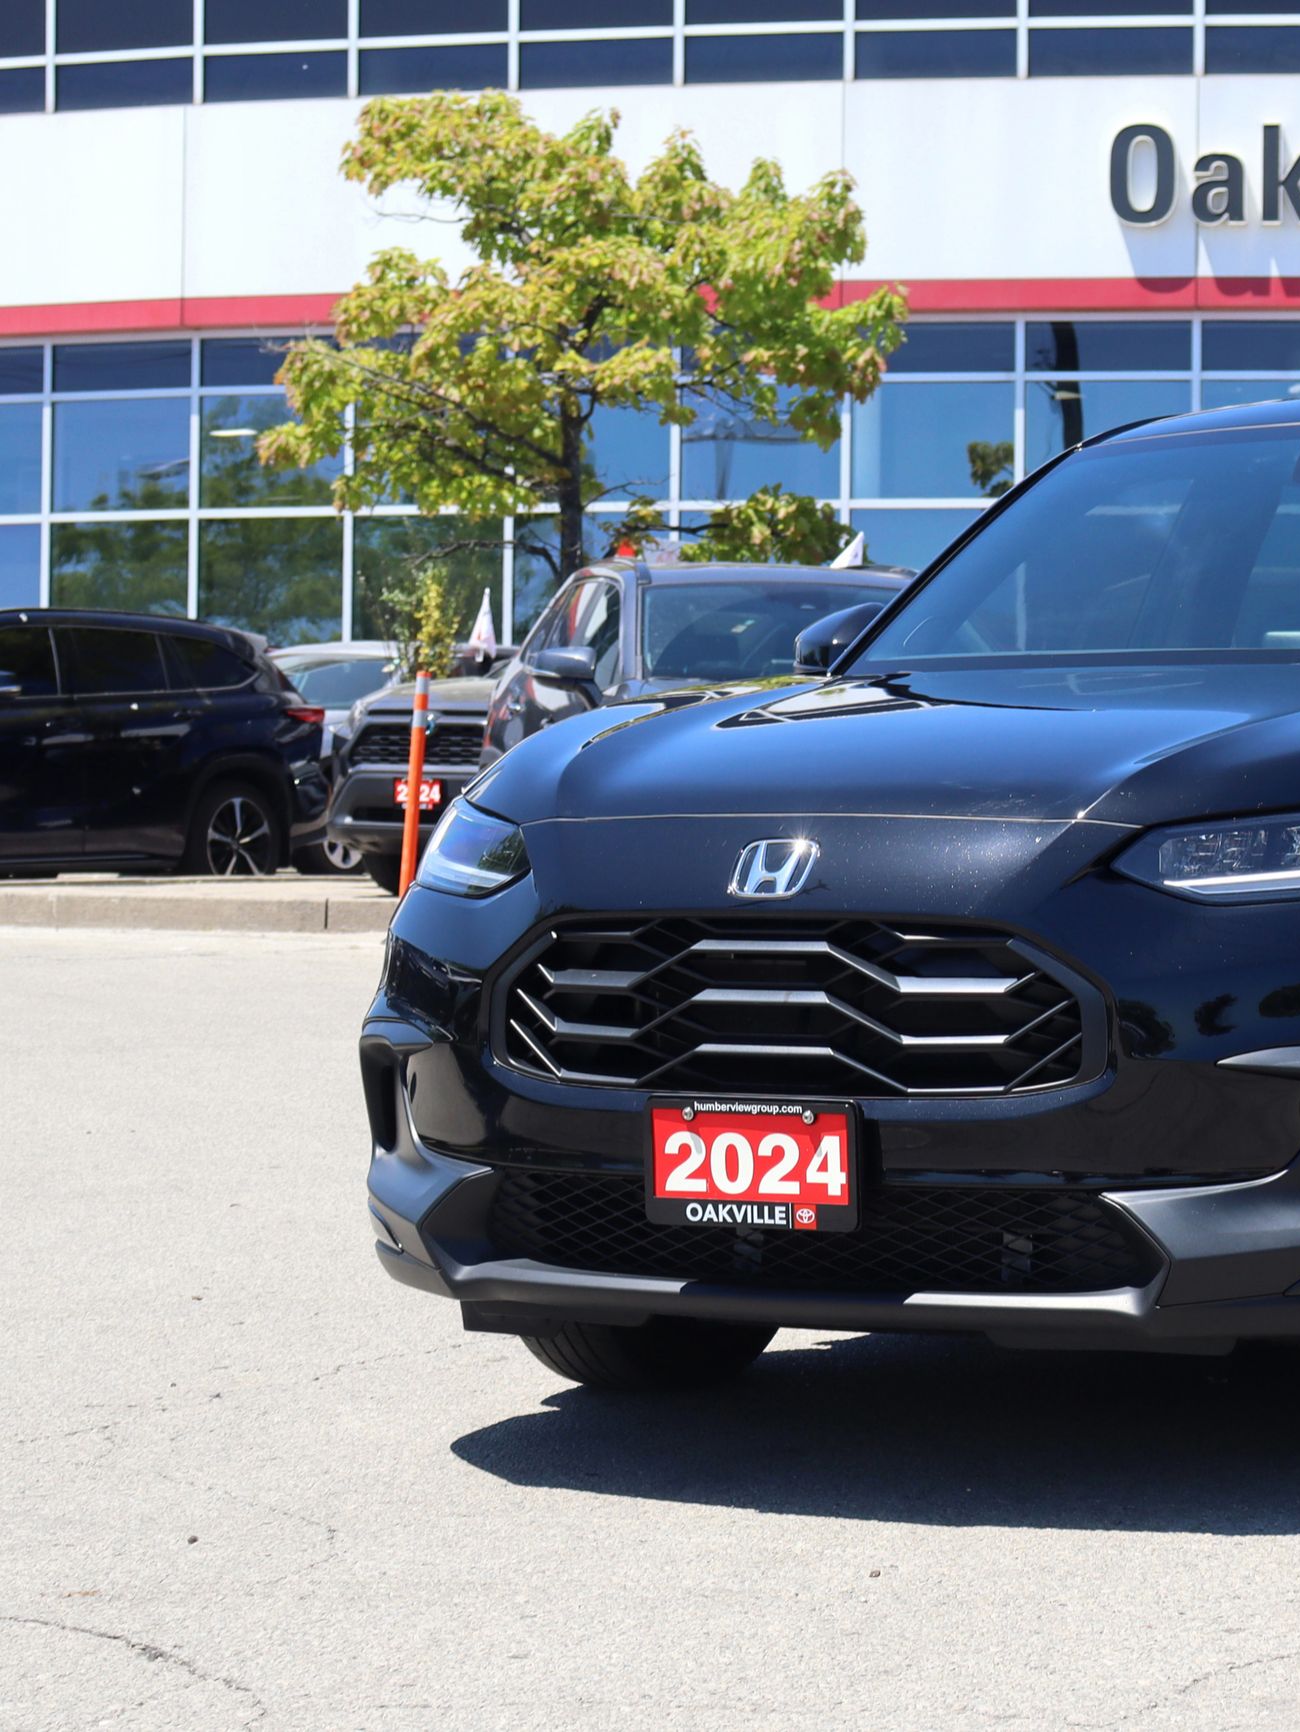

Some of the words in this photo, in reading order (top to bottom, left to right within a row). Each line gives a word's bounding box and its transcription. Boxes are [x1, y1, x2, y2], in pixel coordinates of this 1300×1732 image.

[396, 783, 441, 802] 224
[694, 1101, 803, 1116] humberviewgroup.com
[664, 1130, 847, 1197] 2024
[685, 1202, 787, 1226] OAKVILLE
